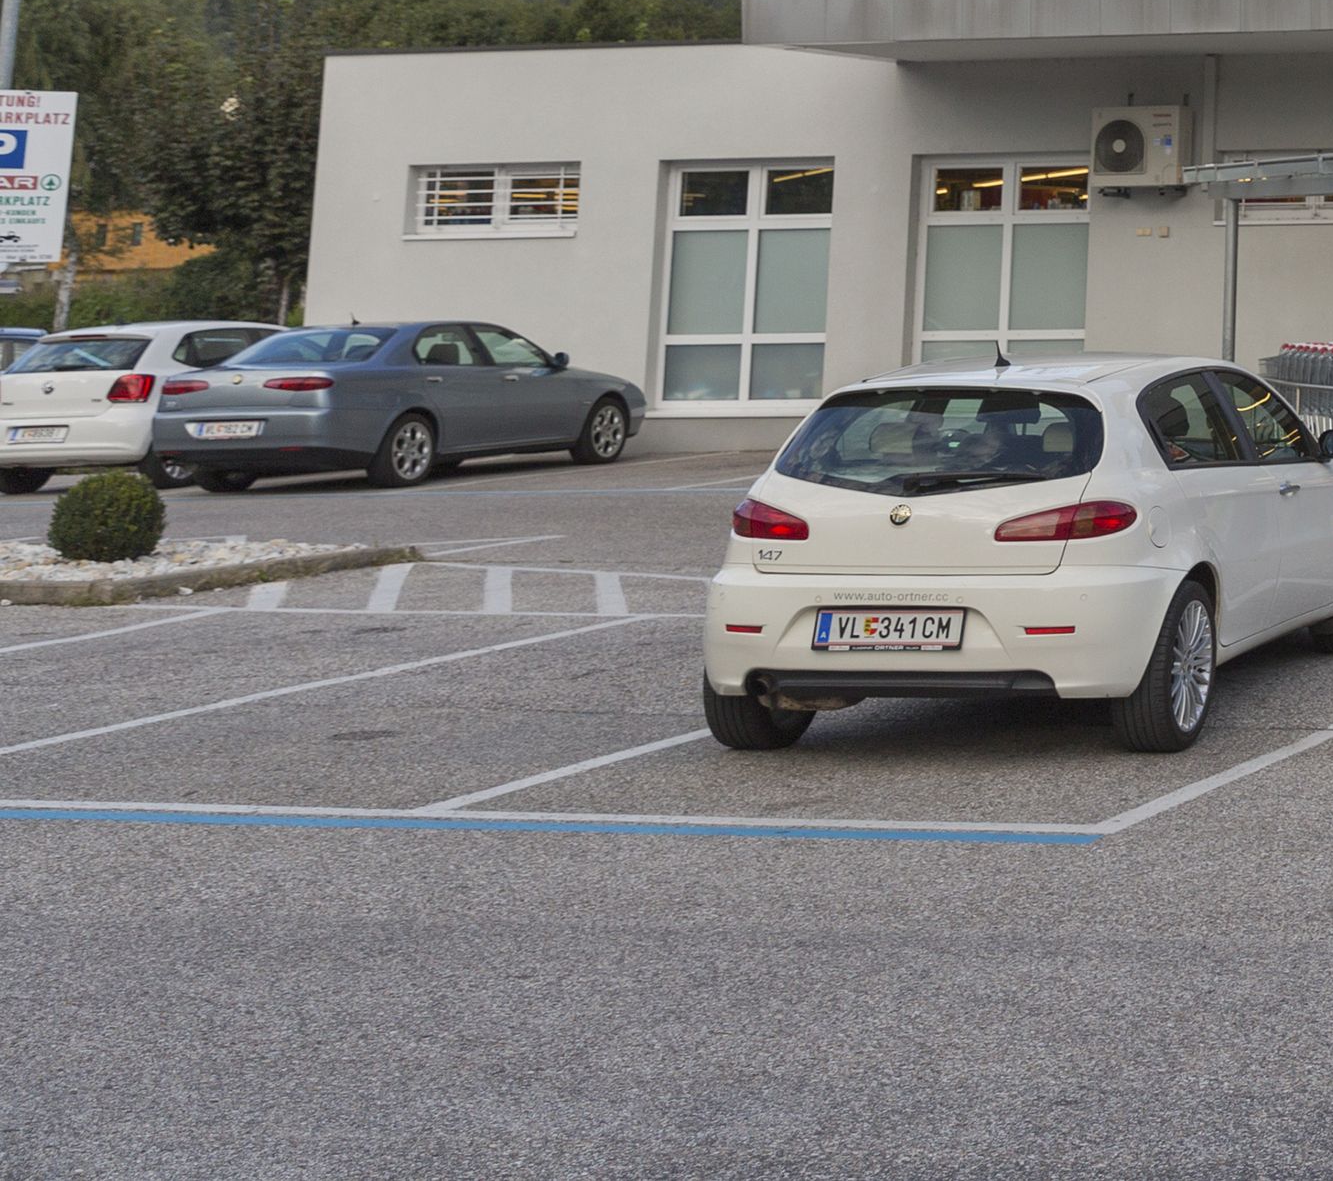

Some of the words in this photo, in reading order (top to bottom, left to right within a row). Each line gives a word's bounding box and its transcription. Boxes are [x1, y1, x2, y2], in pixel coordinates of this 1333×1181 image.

[758, 549, 783, 561] 147
[833, 591, 949, 603] www.auto-ortner.cc
[838, 617, 860, 639] VL
